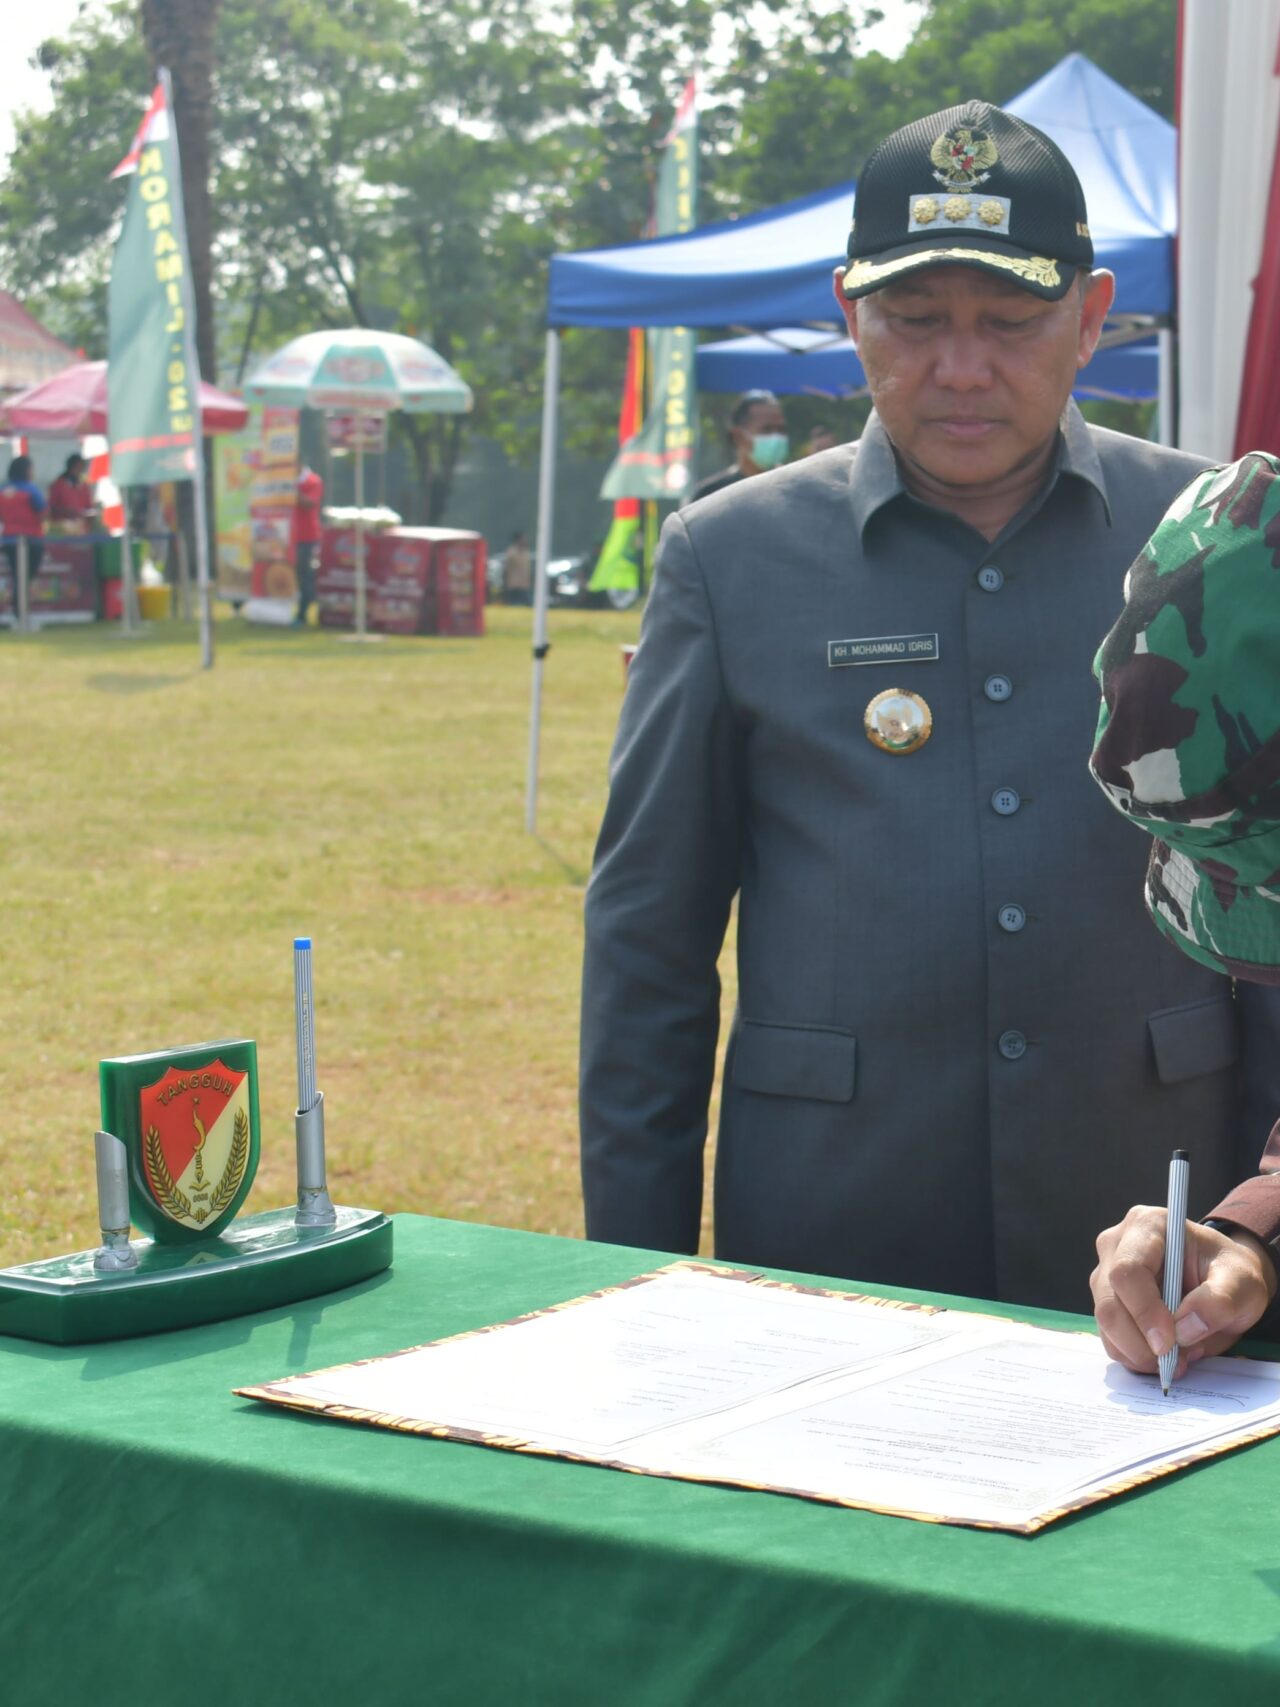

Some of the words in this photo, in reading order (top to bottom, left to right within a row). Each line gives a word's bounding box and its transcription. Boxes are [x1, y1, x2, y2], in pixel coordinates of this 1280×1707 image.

[852, 643, 905, 656] MOHAMMAD
[908, 640, 934, 652] IDRIS
[156, 1072, 234, 1106] TANGGUH
